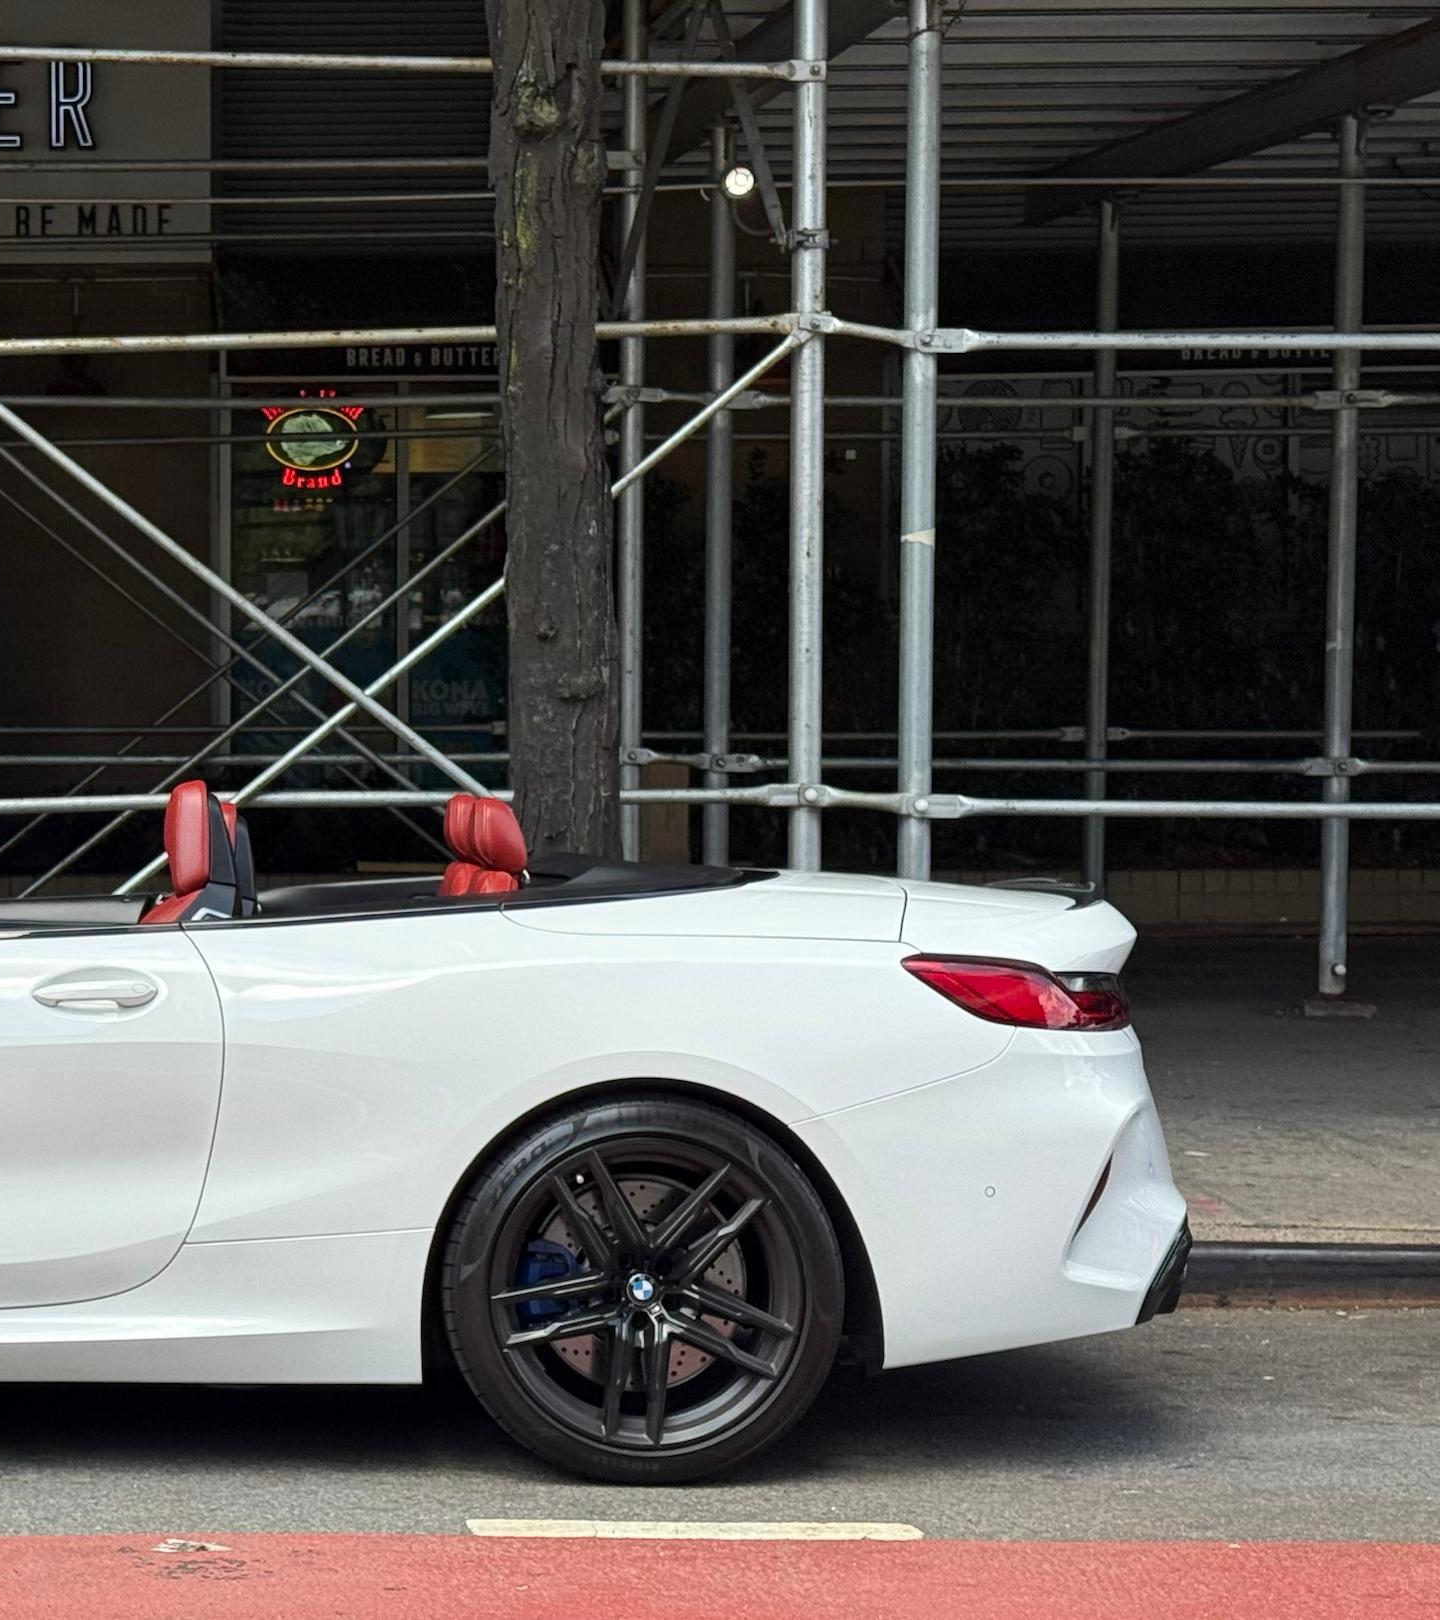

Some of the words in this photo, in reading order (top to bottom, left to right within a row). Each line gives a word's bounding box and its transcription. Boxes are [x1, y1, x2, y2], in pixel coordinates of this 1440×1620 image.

[16, 205, 54, 237] BE
[77, 204, 172, 236] MADE
[346, 347, 406, 367] BREAD
[282, 467, 342, 489] Brand
[411, 680, 488, 701] KONA
